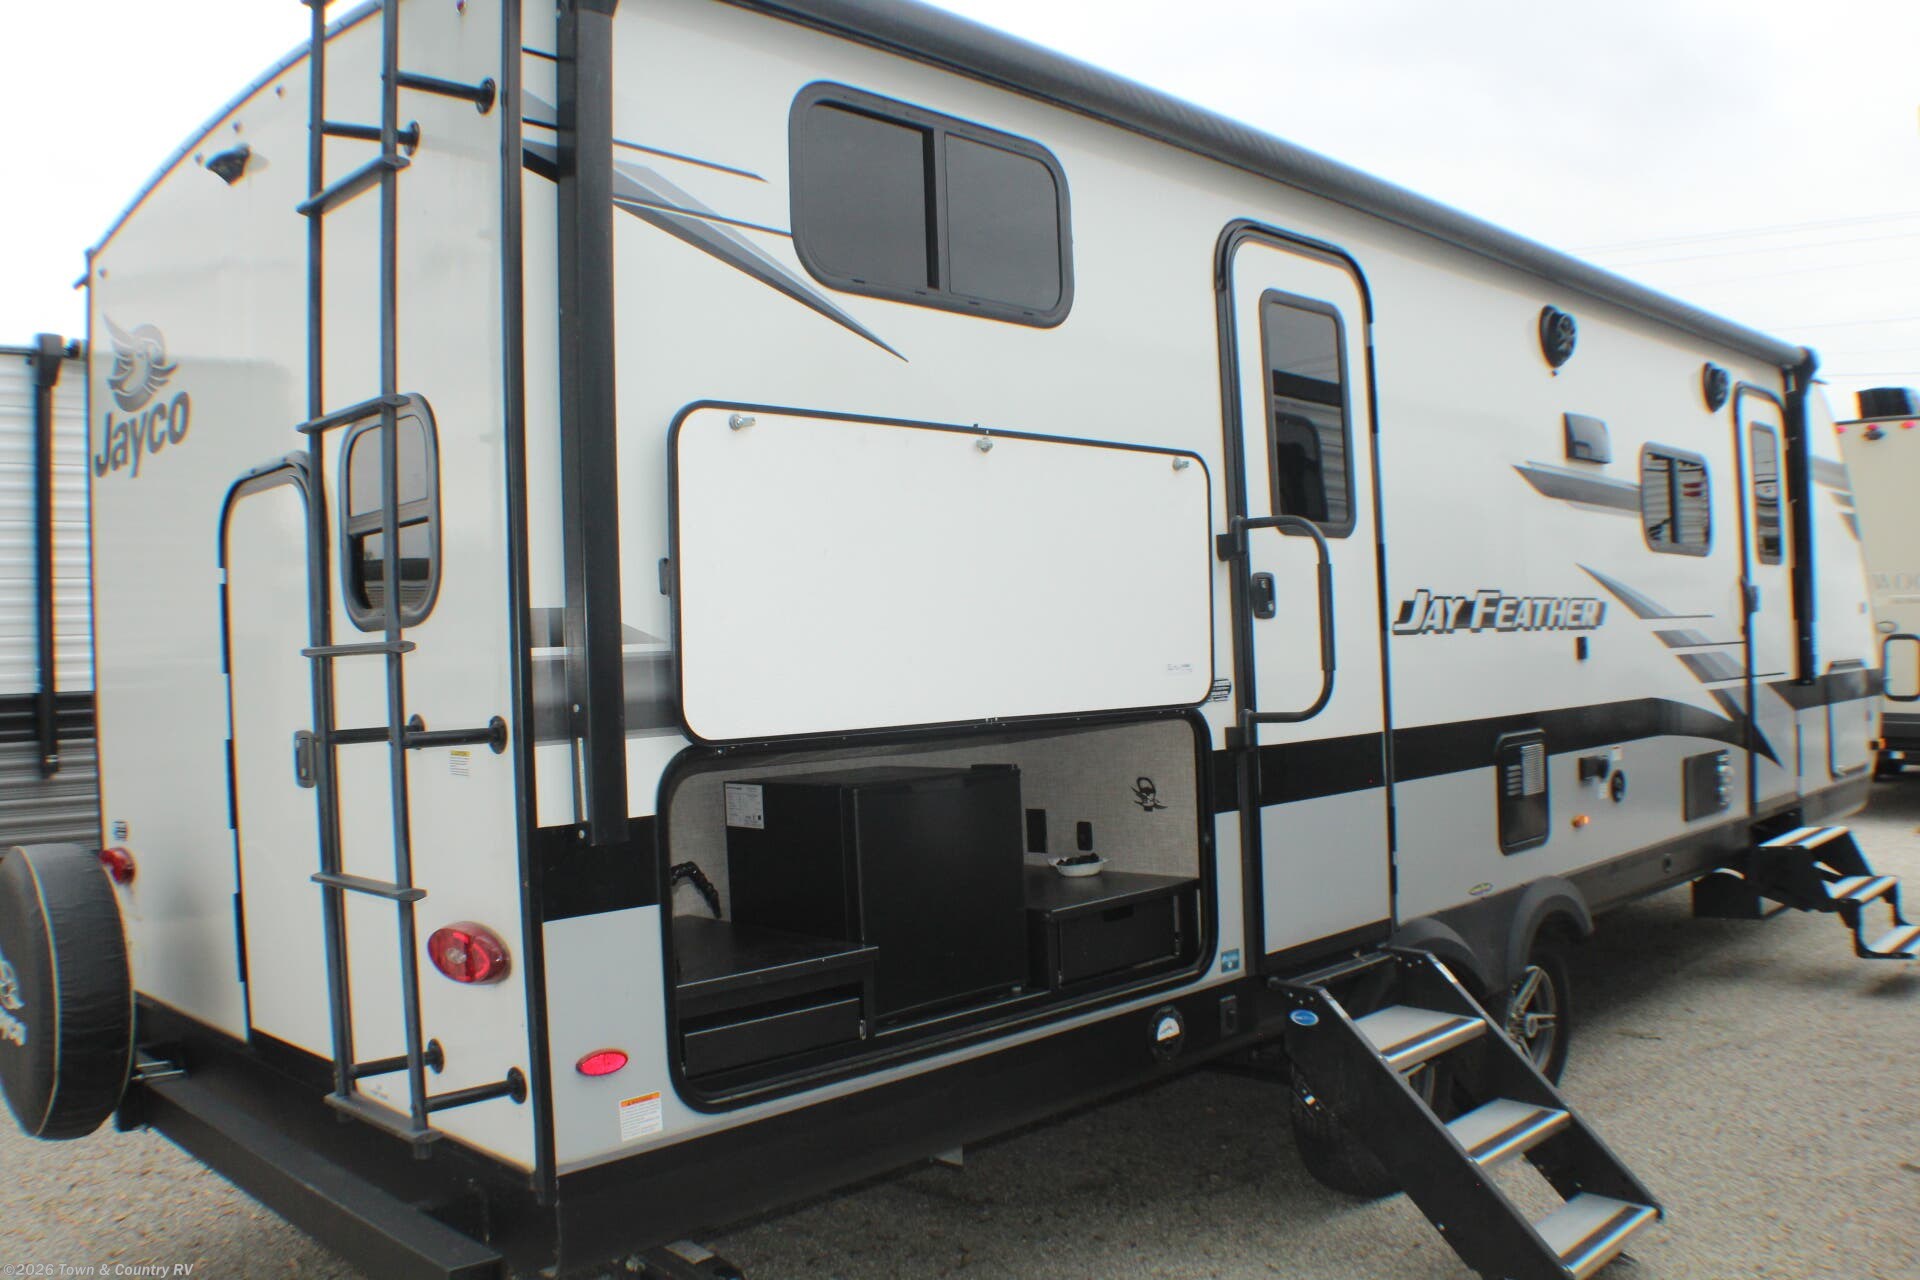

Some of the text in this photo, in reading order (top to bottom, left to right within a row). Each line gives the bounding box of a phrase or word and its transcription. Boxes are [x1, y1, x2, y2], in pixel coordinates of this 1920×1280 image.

[94, 391, 191, 478] Jayco
[1393, 588, 1606, 635] JAY FEATHER
